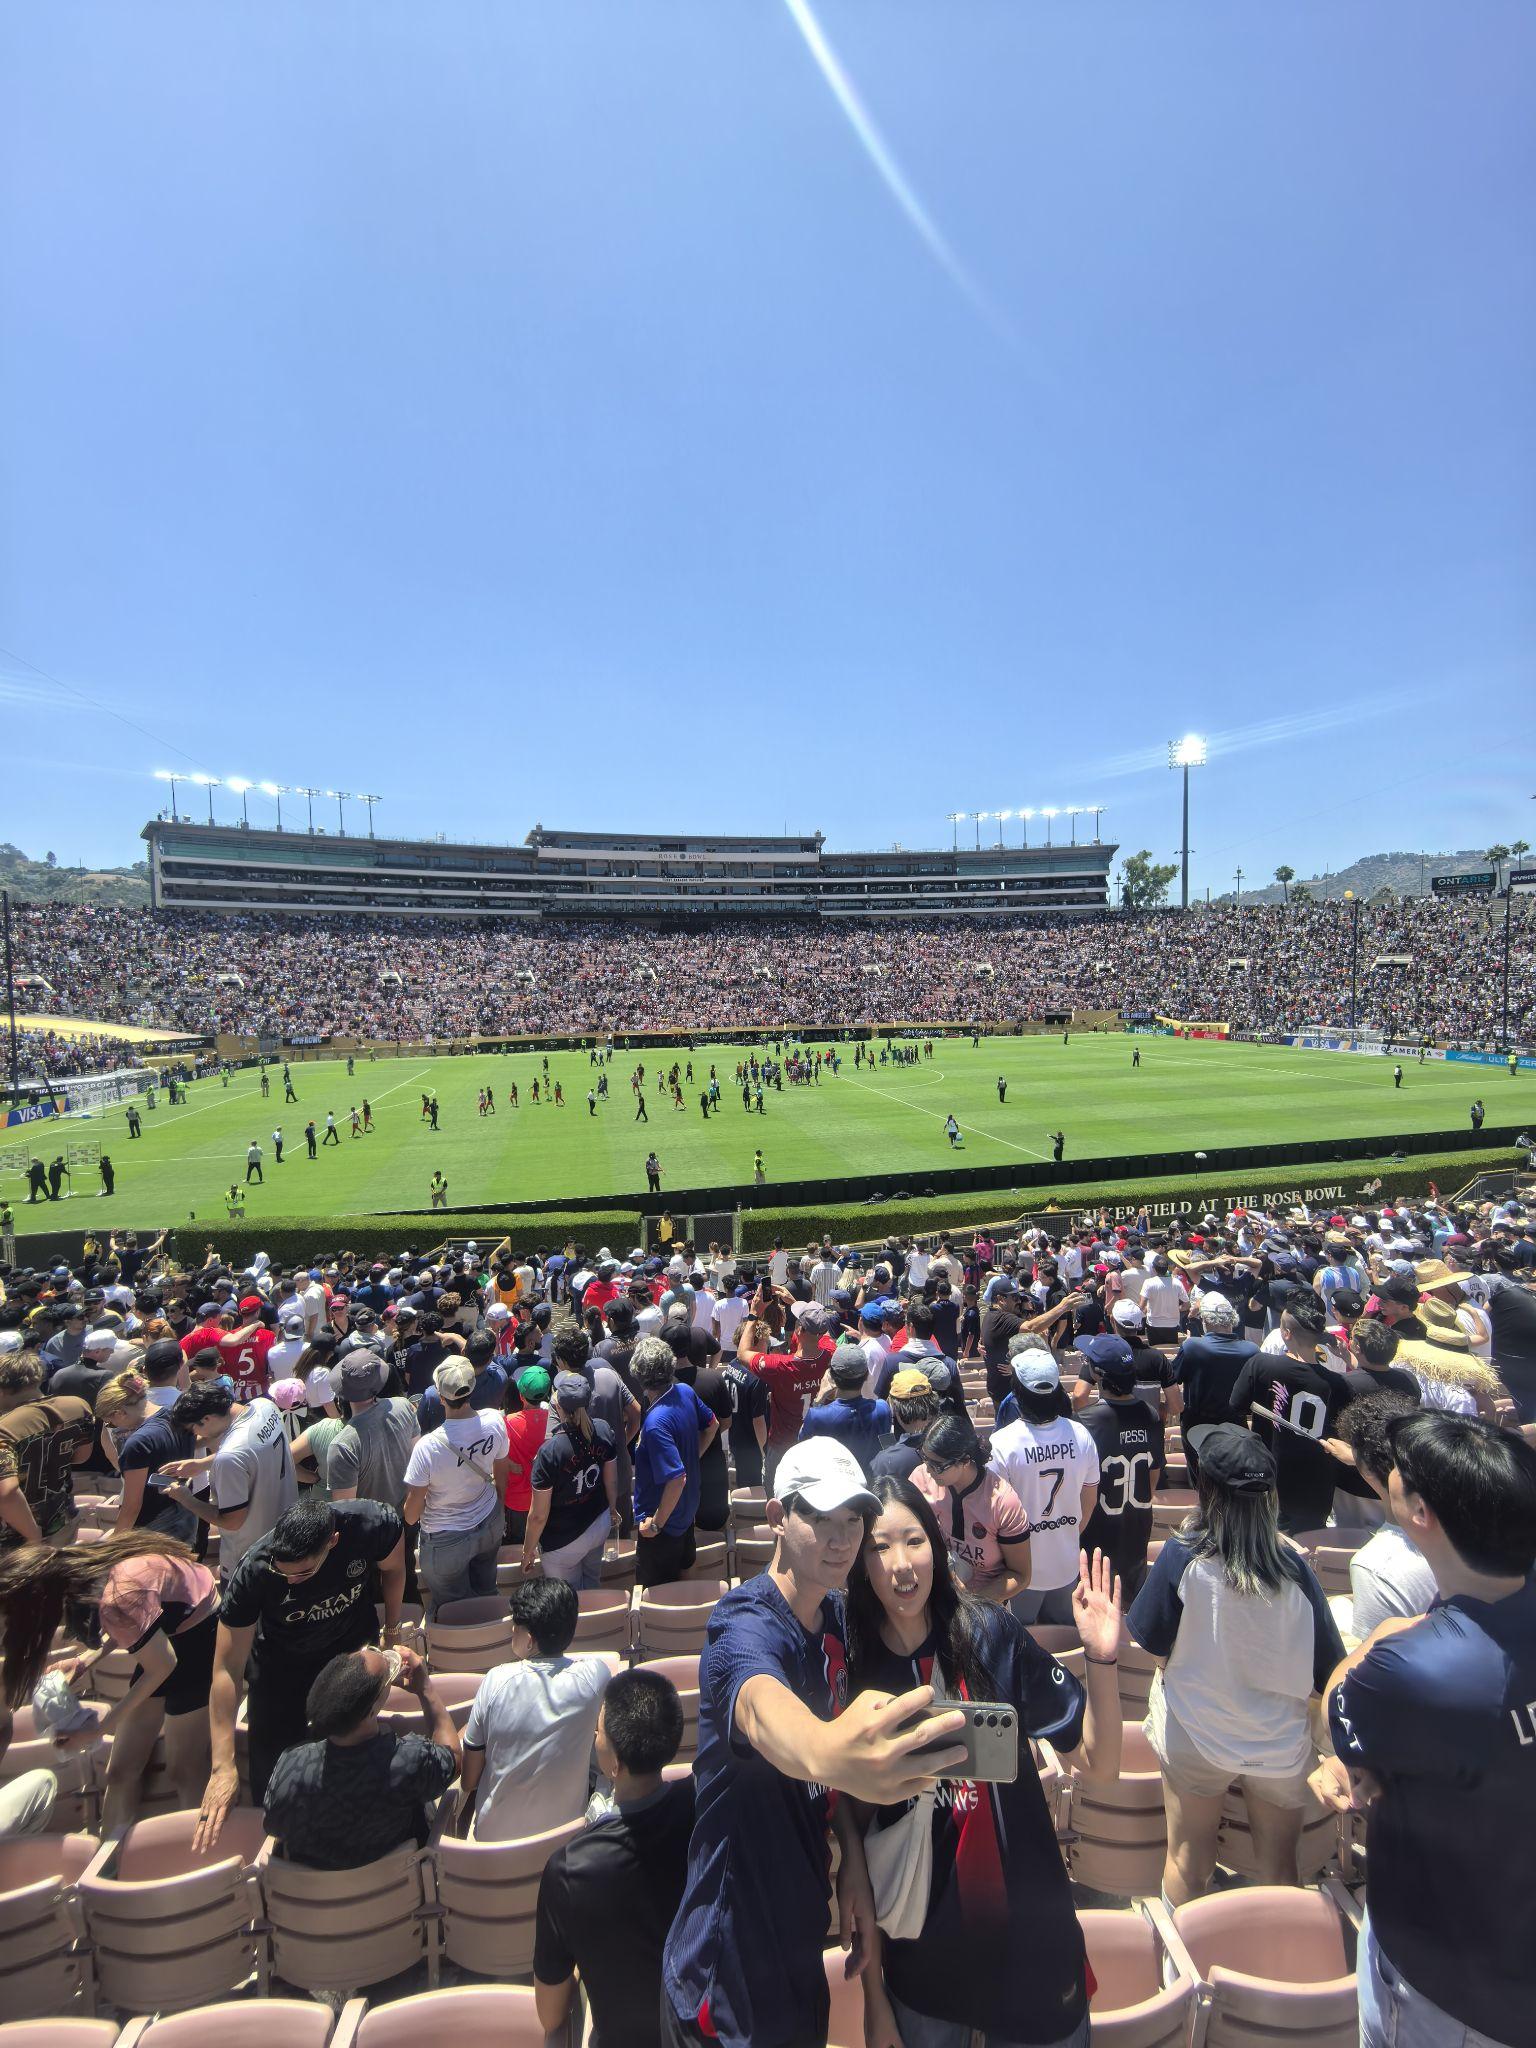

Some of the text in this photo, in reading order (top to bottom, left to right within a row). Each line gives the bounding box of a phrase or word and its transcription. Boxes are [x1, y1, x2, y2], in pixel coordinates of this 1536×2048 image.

[1134, 1026, 1167, 1036] Hisese
[1310, 1039, 1331, 1049] VISA
[18, 1105, 43, 1122] VISA
[1198, 1198, 1219, 1212] AT
[1224, 1195, 1258, 1210] THE
[1262, 1190, 1300, 1206] ROSE
[1305, 1186, 1346, 1202] BOWL
[238, 1347, 255, 1376] 5
[272, 1432, 286, 1480] 7
[1024, 1440, 1076, 1464] MBAPPÉ
[1039, 1467, 1064, 1517] 7
[1101, 1451, 1154, 1516] 30
[945, 1537, 985, 1561] ATAR
[286, 1583, 362, 1622] QATAR
